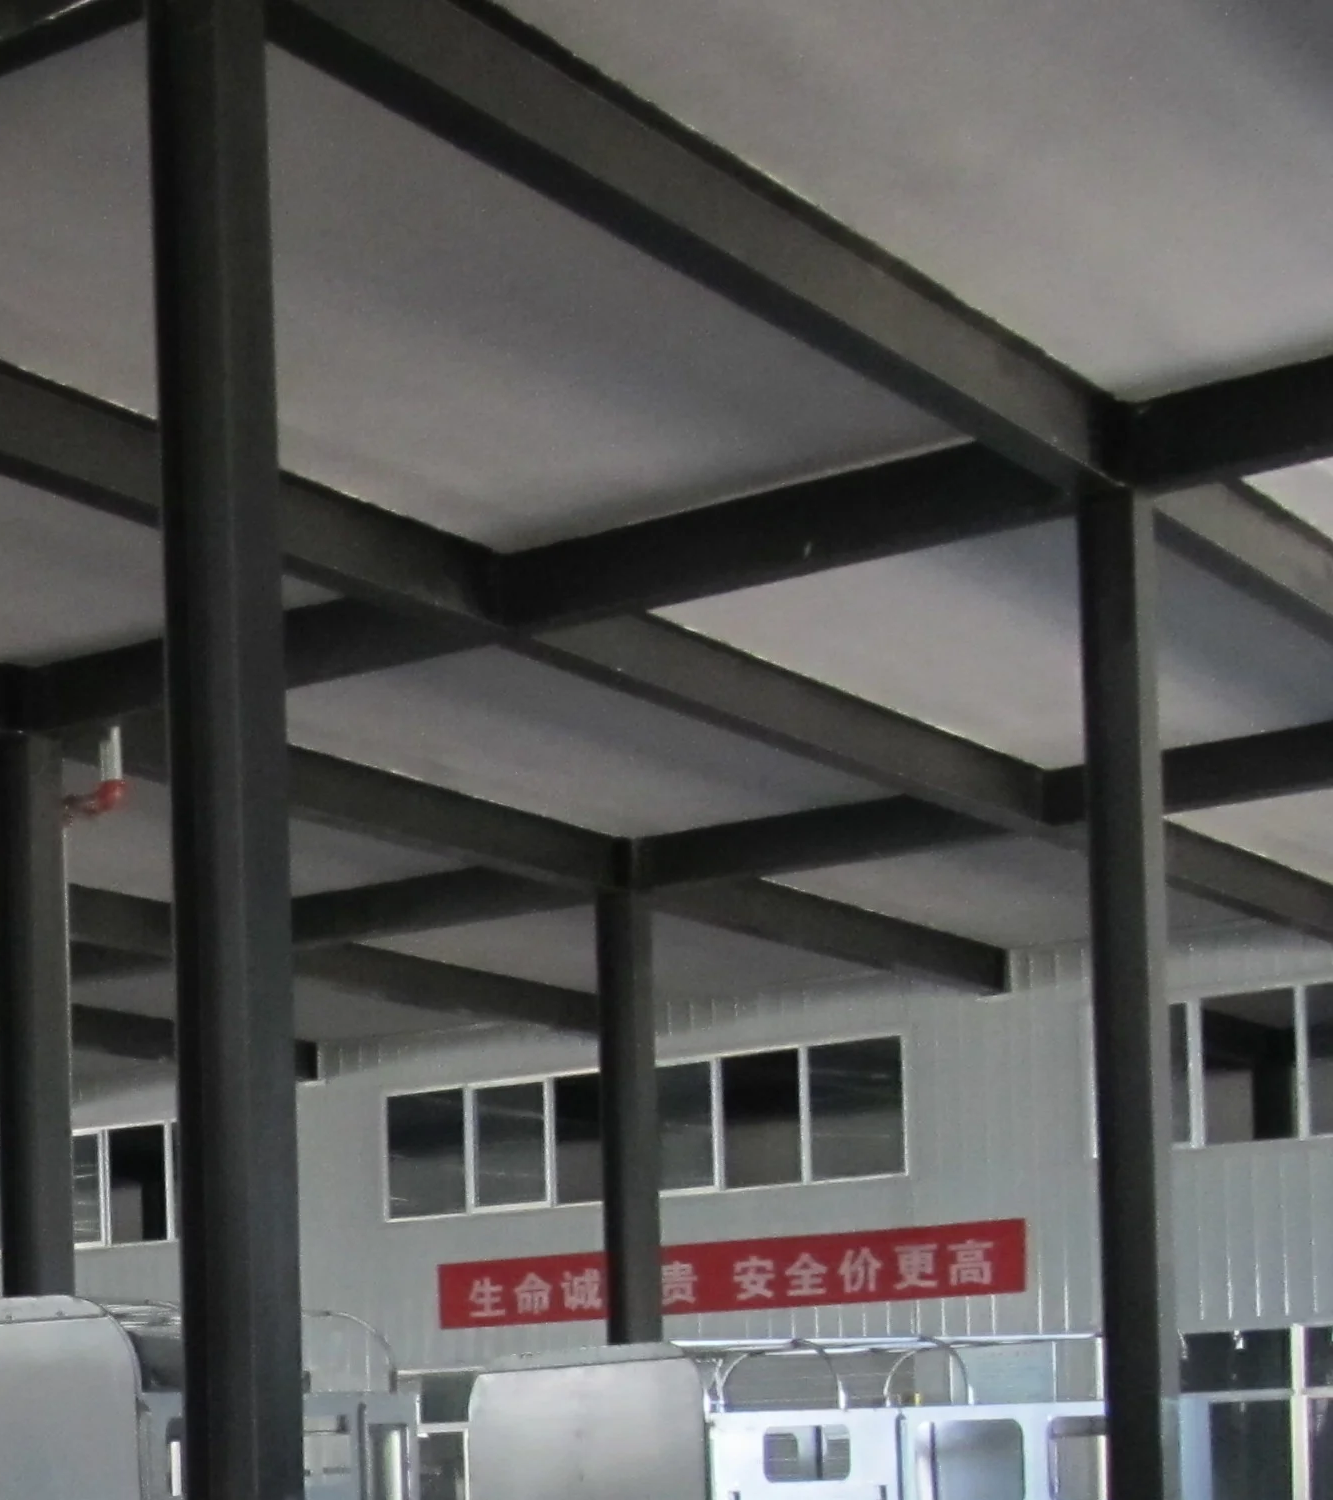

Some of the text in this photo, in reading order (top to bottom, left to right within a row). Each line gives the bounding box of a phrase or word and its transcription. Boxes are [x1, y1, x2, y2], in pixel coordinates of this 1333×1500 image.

[468, 1239, 994, 1317] 生命诚贵 安全价更高
